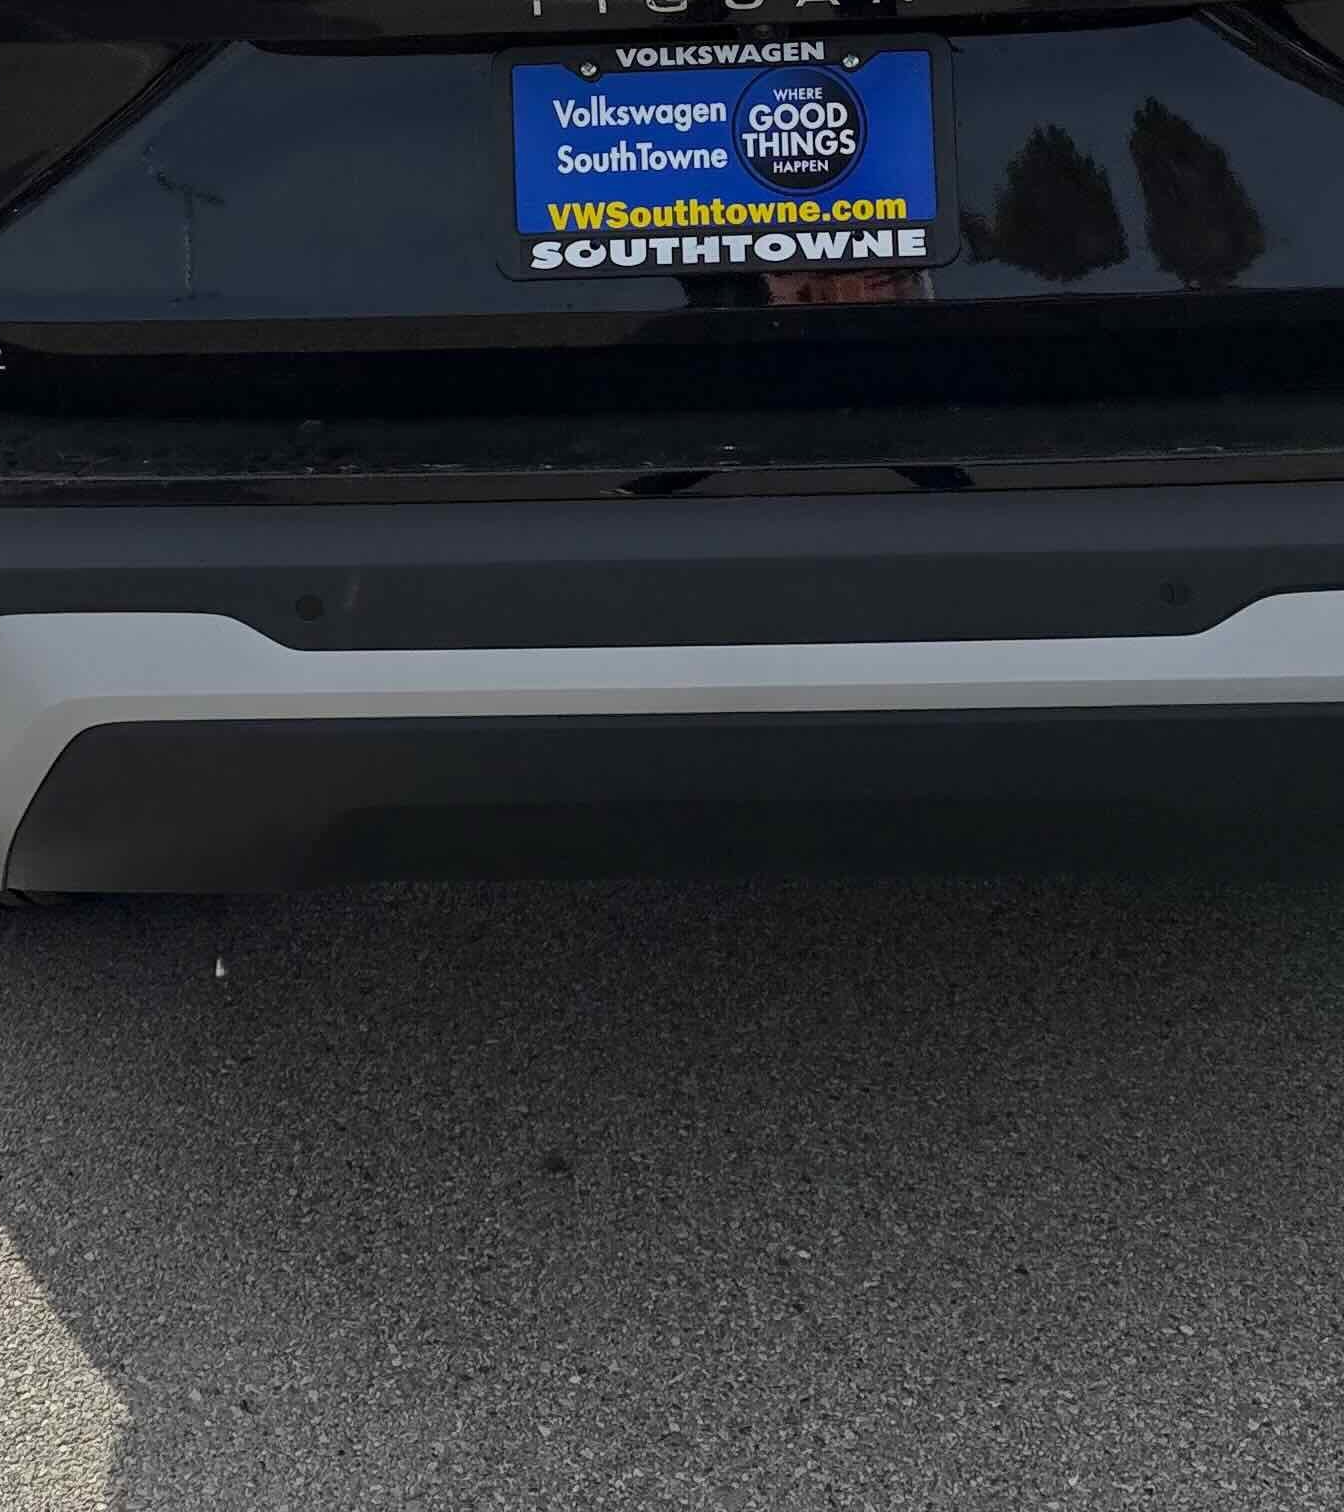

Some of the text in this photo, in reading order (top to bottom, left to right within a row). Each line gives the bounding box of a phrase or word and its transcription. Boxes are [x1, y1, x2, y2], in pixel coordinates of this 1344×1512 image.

[615, 41, 825, 68] VOLKSWAGEN
[773, 87, 823, 101] WHERE
[553, 96, 727, 132] Volkswagen
[748, 103, 848, 131] GOOD
[557, 142, 728, 175] SouthTowne
[742, 129, 856, 159] THINGS
[772, 159, 829, 174] HAPPEN
[548, 197, 907, 231] VWSouthtowne.com
[530, 228, 928, 270] SOUTHTOWNE
